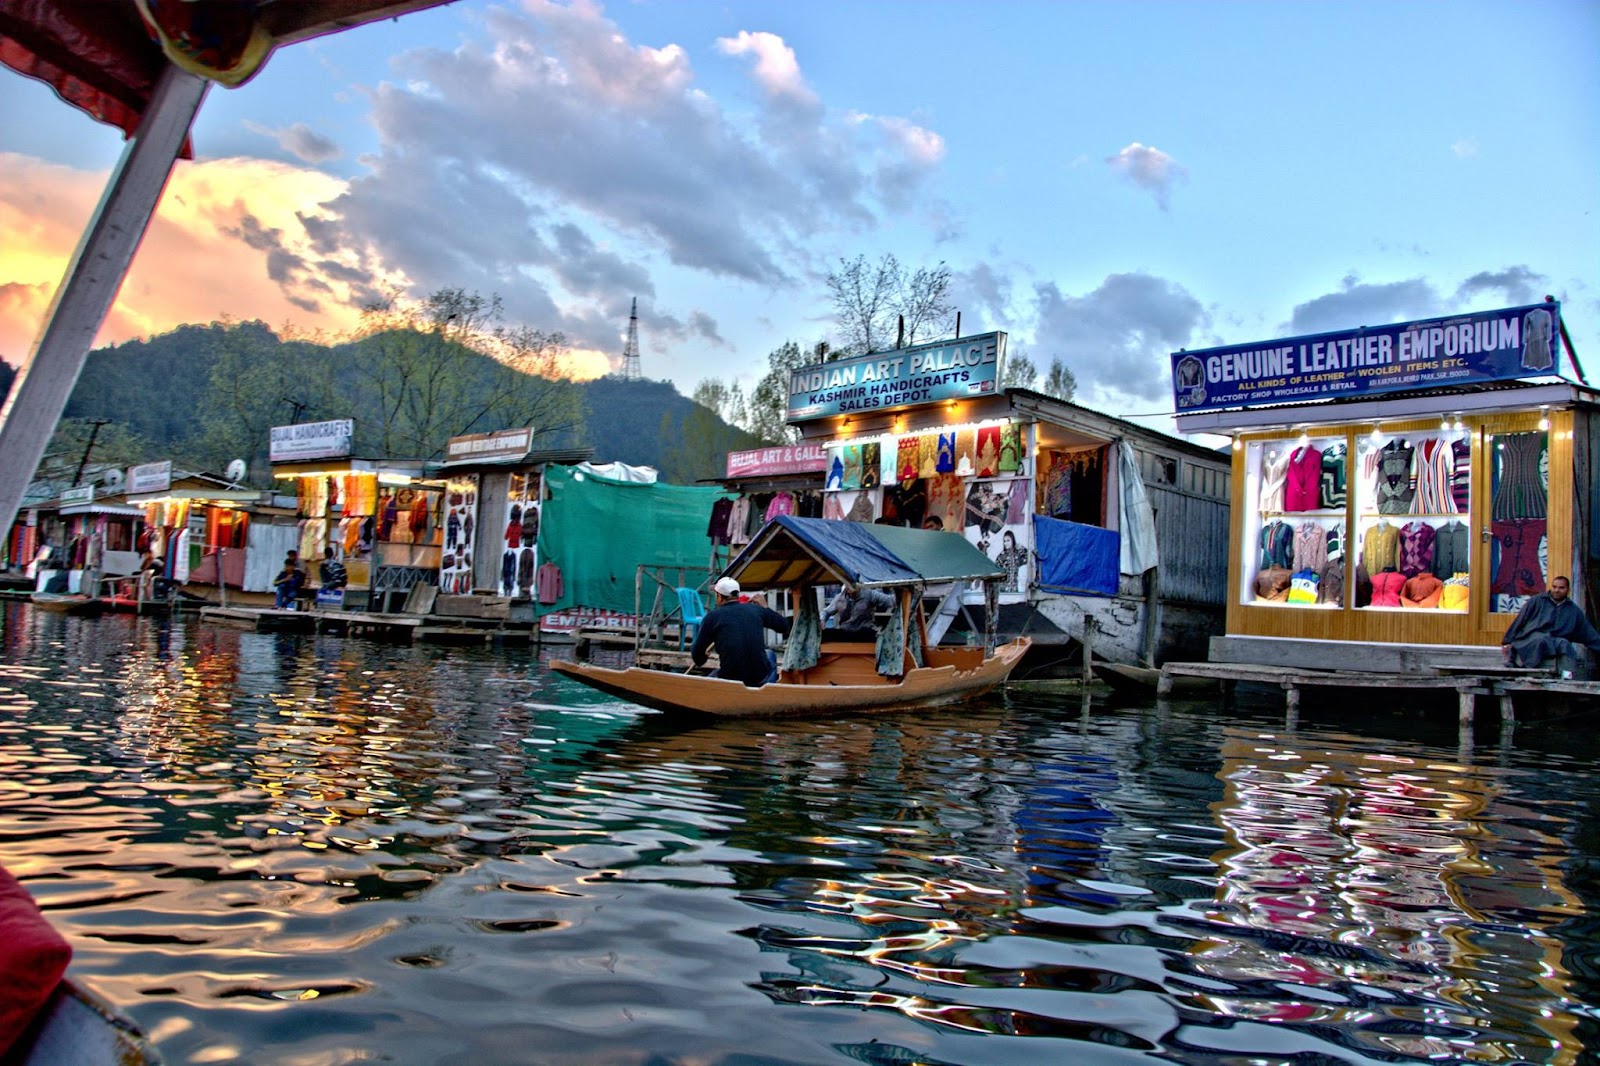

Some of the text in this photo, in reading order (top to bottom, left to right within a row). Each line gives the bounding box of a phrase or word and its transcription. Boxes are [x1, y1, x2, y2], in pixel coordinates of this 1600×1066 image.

[1206, 317, 1519, 384] GENUINE LEATHER EMPORIUM
[791, 365, 857, 395] INDIAN
[861, 357, 904, 384] ART
[909, 342, 996, 376] PALACE
[1238, 382, 1256, 390] ALL
[1257, 378, 1286, 389] KINDS
[1289, 377, 1302, 385] OF
[1304, 372, 1345, 384] LEATHER
[1358, 365, 1402, 377] WOOLEN
[1406, 360, 1439, 372] ITEMS
[1442, 358, 1468, 368] ETC.
[809, 371, 969, 405] KASHMIR HANDICRAFTS
[1211, 393, 1249, 403] FACTORY
[1251, 390, 1272, 399] SHOP
[1274, 385, 1319, 396] WHOLESALE
[1330, 382, 1357, 391] RETAIL
[839, 389, 931, 411] SALES DEPOT.
[294, 420, 350, 440] HANDICRAFTS
[761, 449, 782, 463] ART
[784, 448, 792, 462] &
[546, 614, 659, 630] EMPORI
